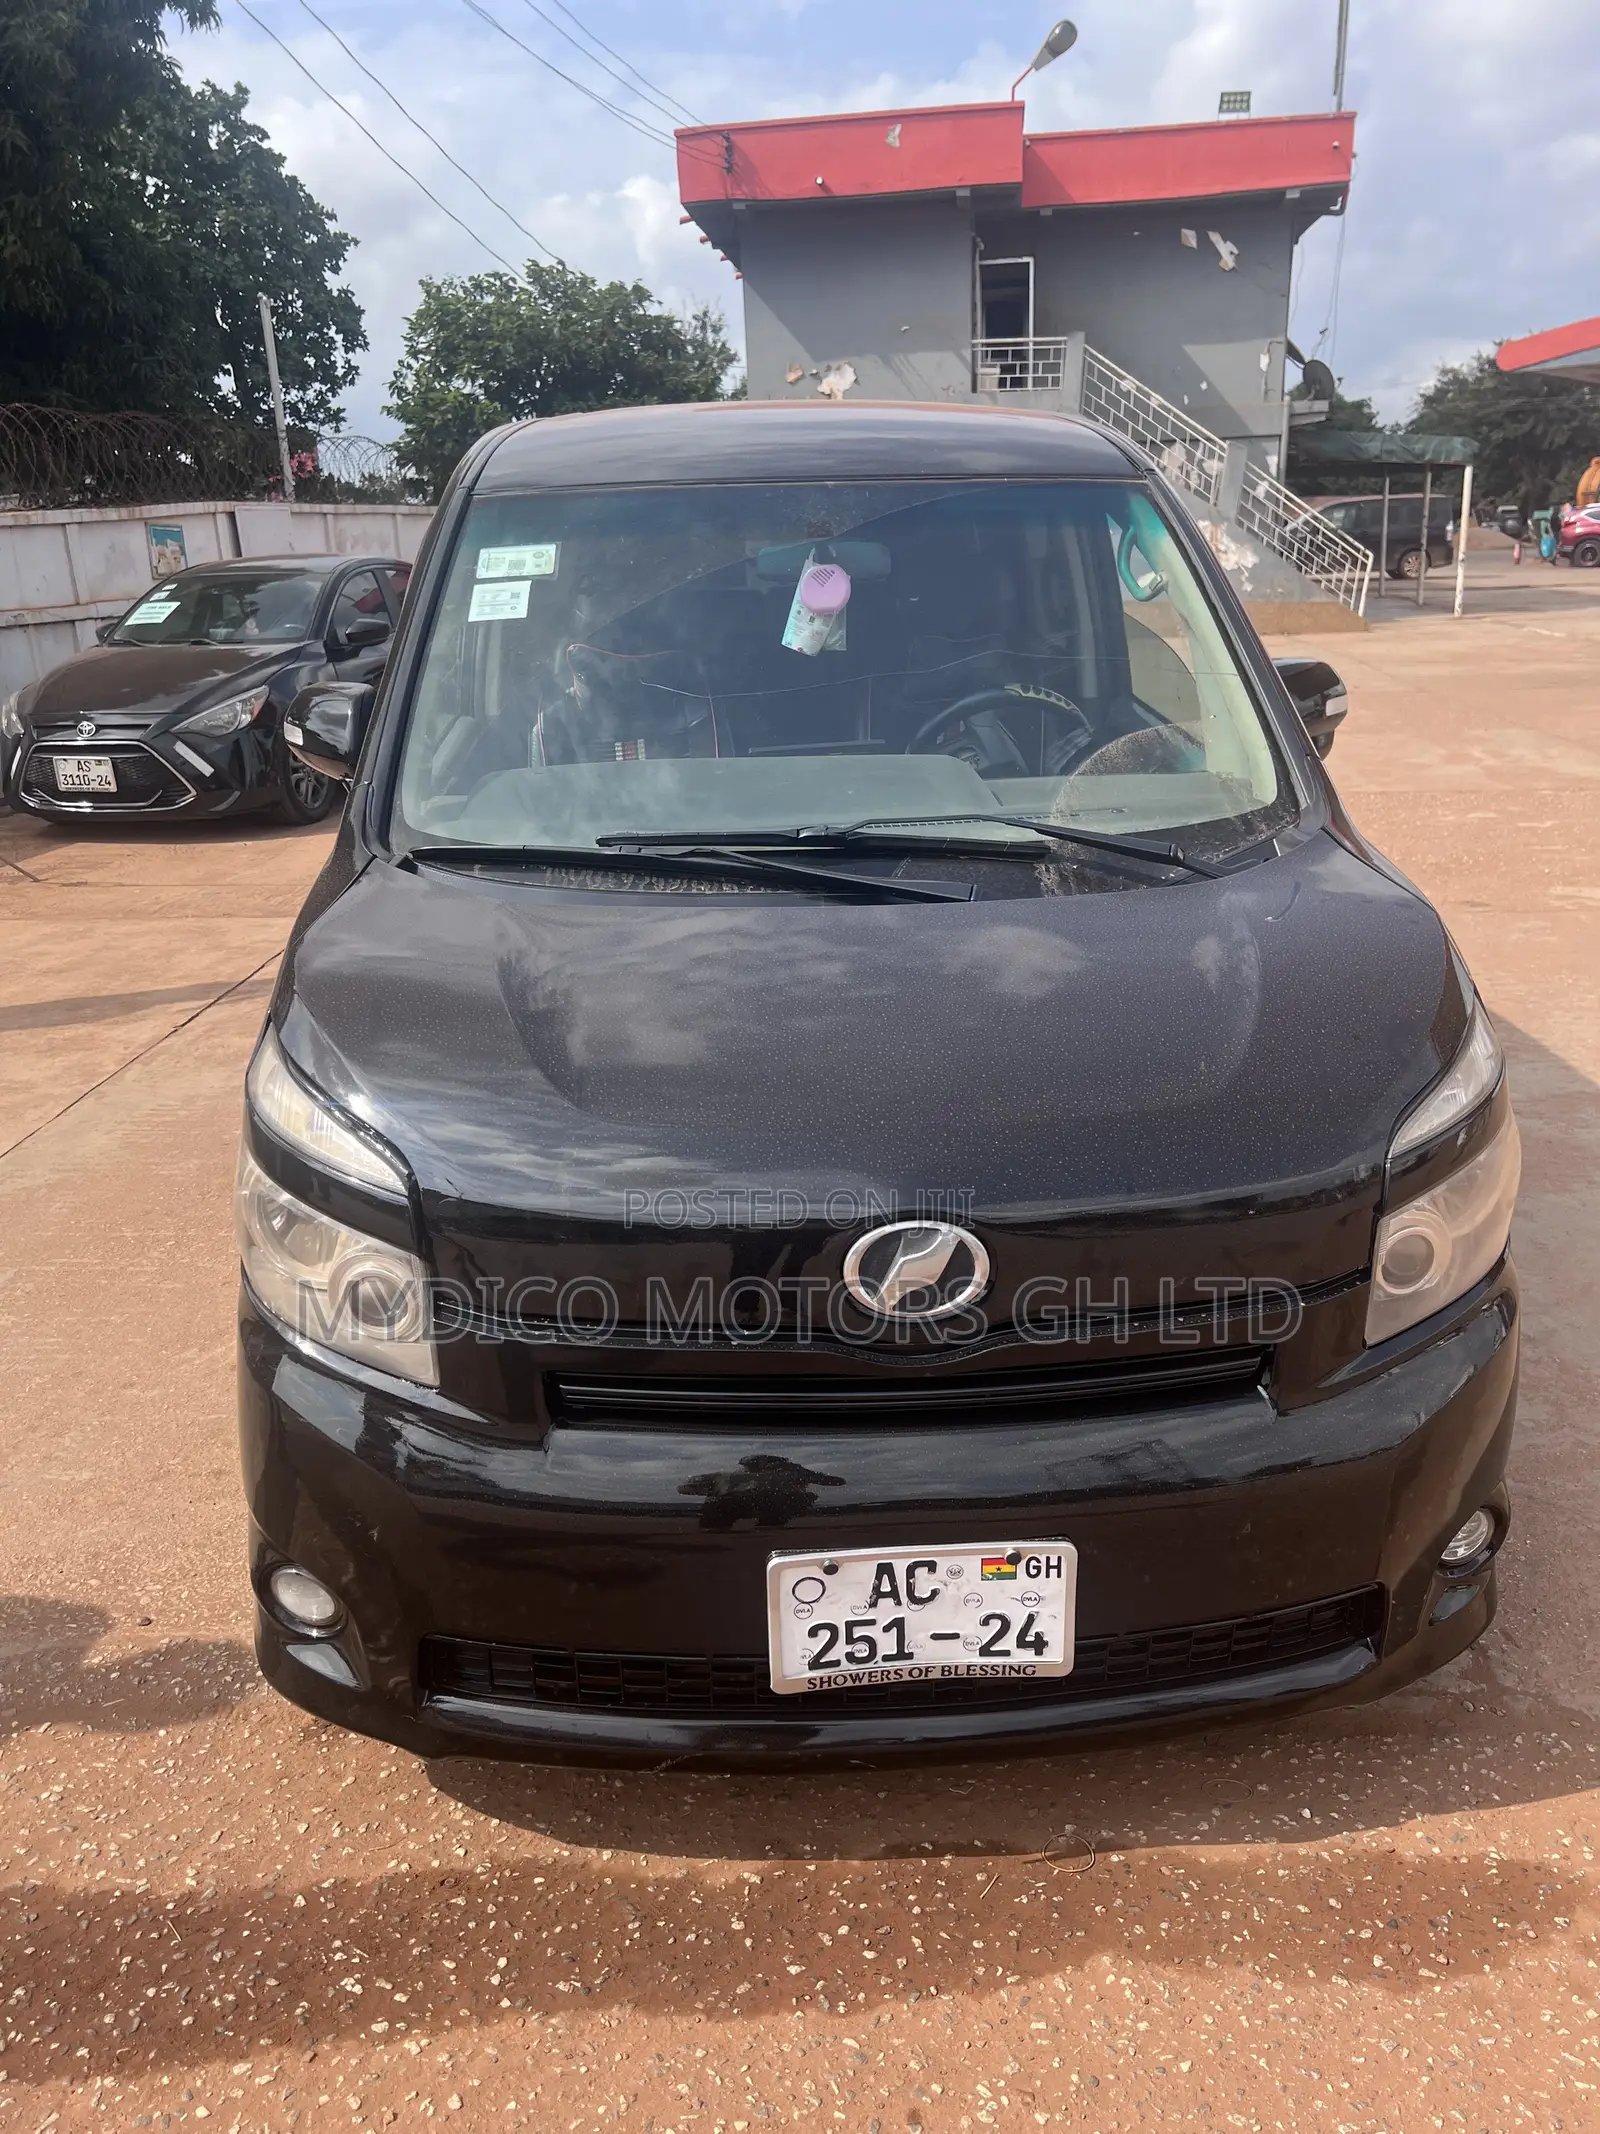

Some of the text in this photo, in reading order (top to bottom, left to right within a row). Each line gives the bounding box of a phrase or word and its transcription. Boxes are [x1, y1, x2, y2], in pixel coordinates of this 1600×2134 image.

[77, 760, 92, 773] AS
[61, 773, 112, 787] 3110-24
[1025, 1555, 1062, 1579] GH
[868, 1559, 941, 1608] AC
[807, 1664, 1037, 1690] SHOWERS OF BLESSING
